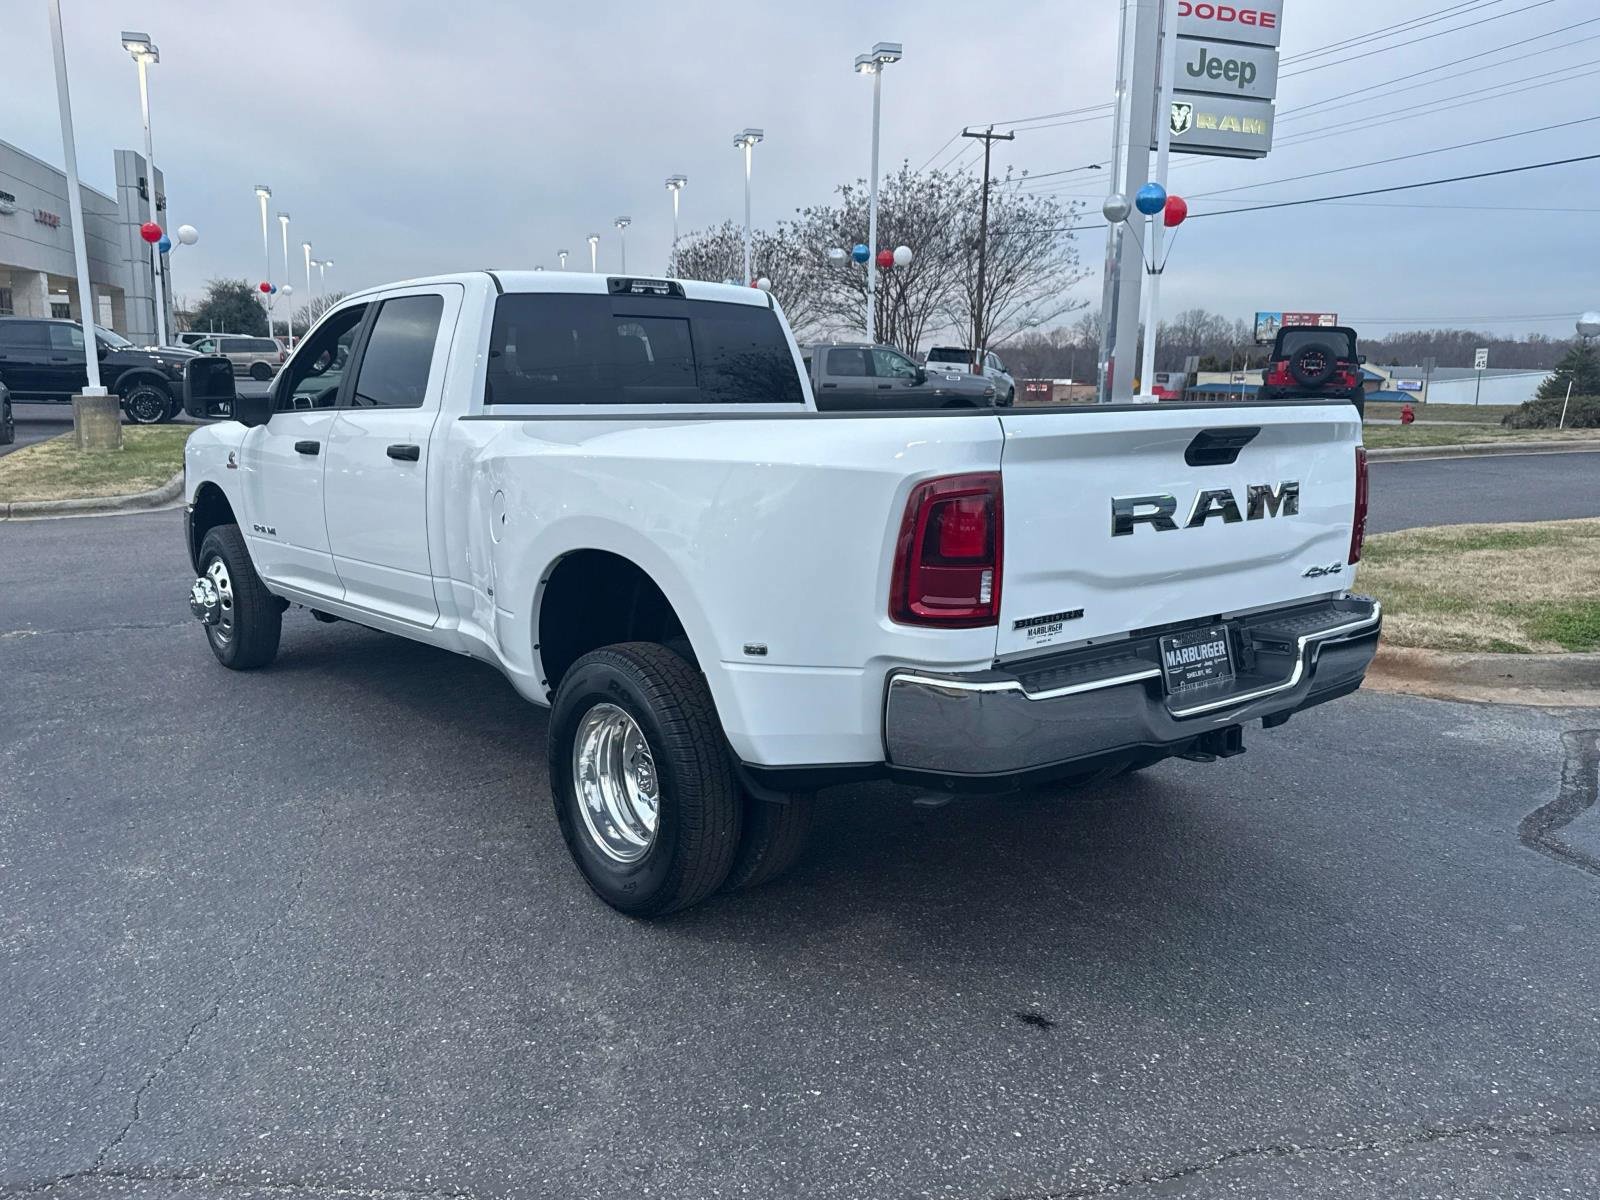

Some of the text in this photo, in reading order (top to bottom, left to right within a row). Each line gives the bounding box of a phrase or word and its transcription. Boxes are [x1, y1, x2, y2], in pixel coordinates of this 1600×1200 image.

[1186, 48, 1257, 88] Jeep
[1196, 113, 1265, 135] RAM
[1476, 360, 1486, 368] 45
[1110, 480, 1300, 537] RAM
[1027, 622, 1063, 637] MARBURGER
[1166, 640, 1226, 667] MARBURGER
